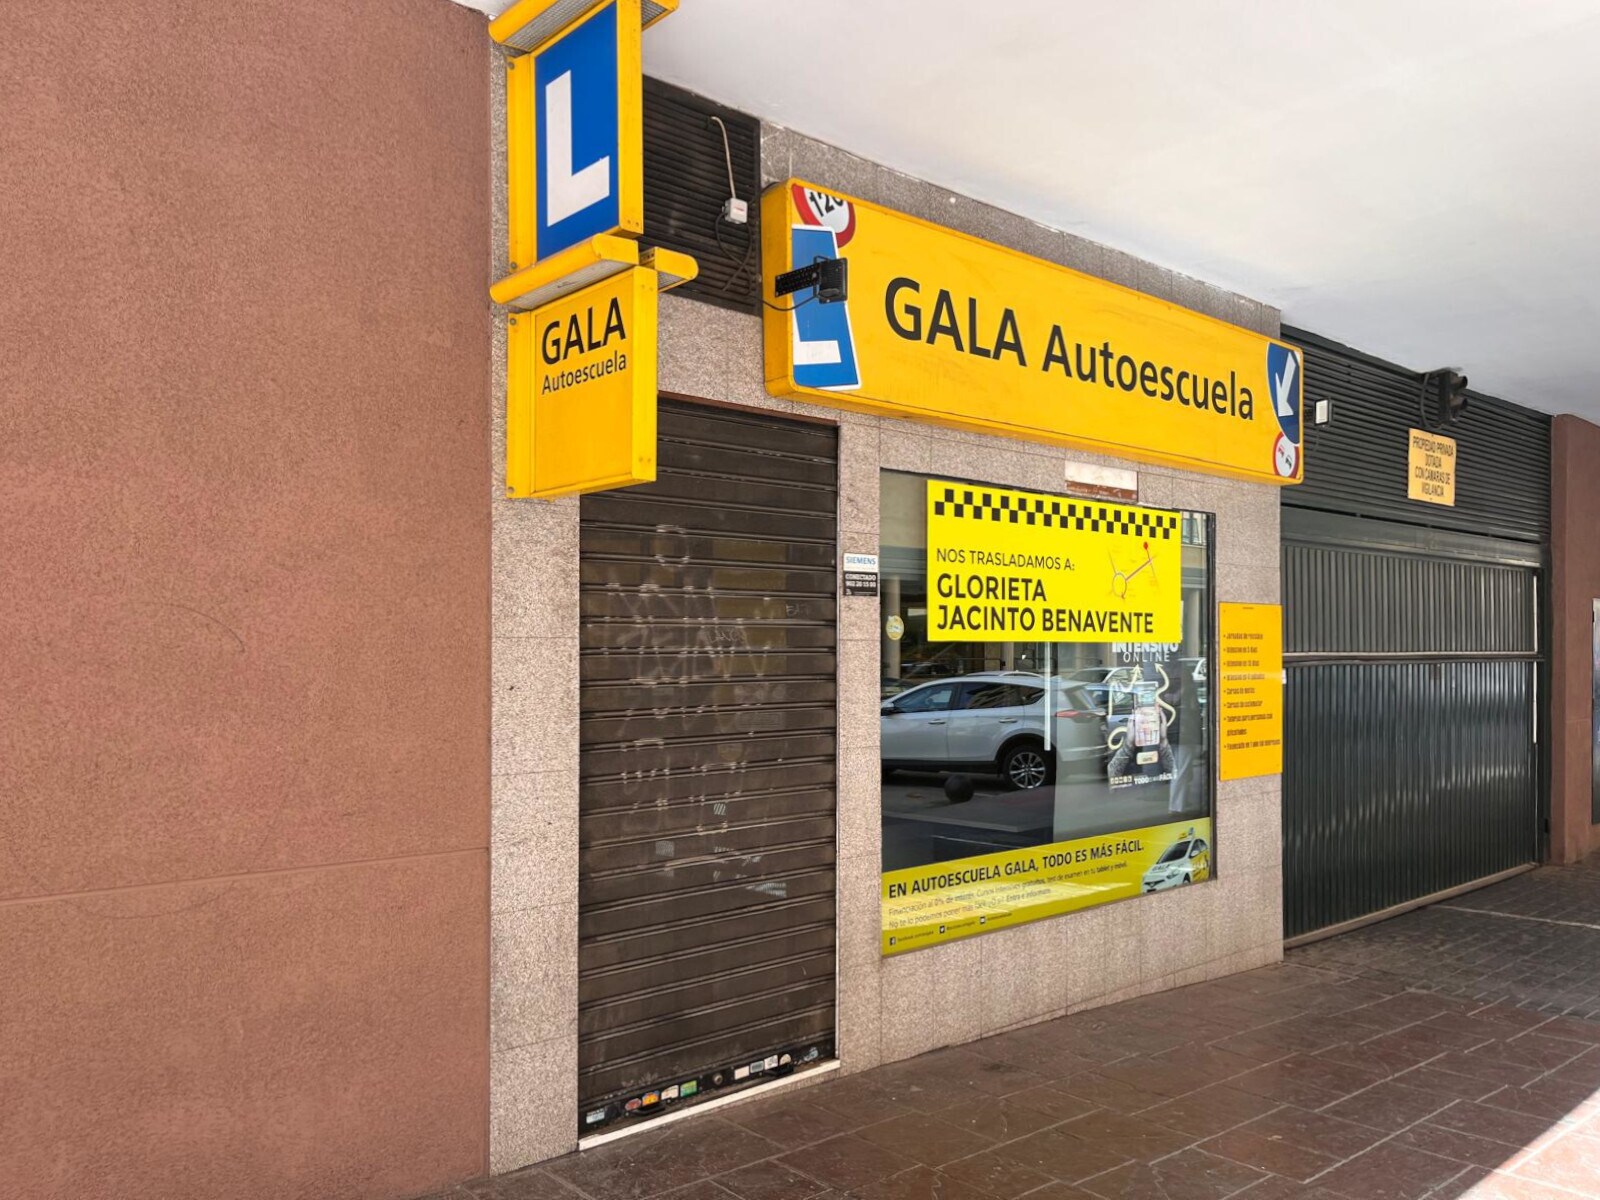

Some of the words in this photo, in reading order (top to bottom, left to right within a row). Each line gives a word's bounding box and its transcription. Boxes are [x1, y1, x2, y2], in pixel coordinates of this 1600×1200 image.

[546, 69, 610, 227] L
[541, 297, 627, 365] GALA
[884, 277, 1027, 368] GALA
[1042, 324, 1254, 421] Autoescuela
[541, 350, 627, 395] Autoescuela
[846, 556, 876, 565] SIEMENS
[936, 548, 966, 563] NOS
[969, 551, 1061, 570] TRASLADAMOS
[1064, 558, 1075, 571] A:
[937, 574, 1047, 601] GLORIETA
[936, 605, 1035, 631] JACINTO
[1042, 608, 1154, 633] BENAVENTE
[1112, 642, 1179, 653] INTENSIVO
[1123, 651, 1170, 662] ONLINE
[889, 882, 906, 898] EN
[912, 865, 1001, 894] AUTOESCUELA
[1005, 859, 1038, 876] GALA,
[1043, 852, 1072, 868] TODO
[1076, 850, 1087, 863] ES
[1090, 843, 1112, 860] MÁS
[1116, 838, 1144, 854] FÁCIL.
